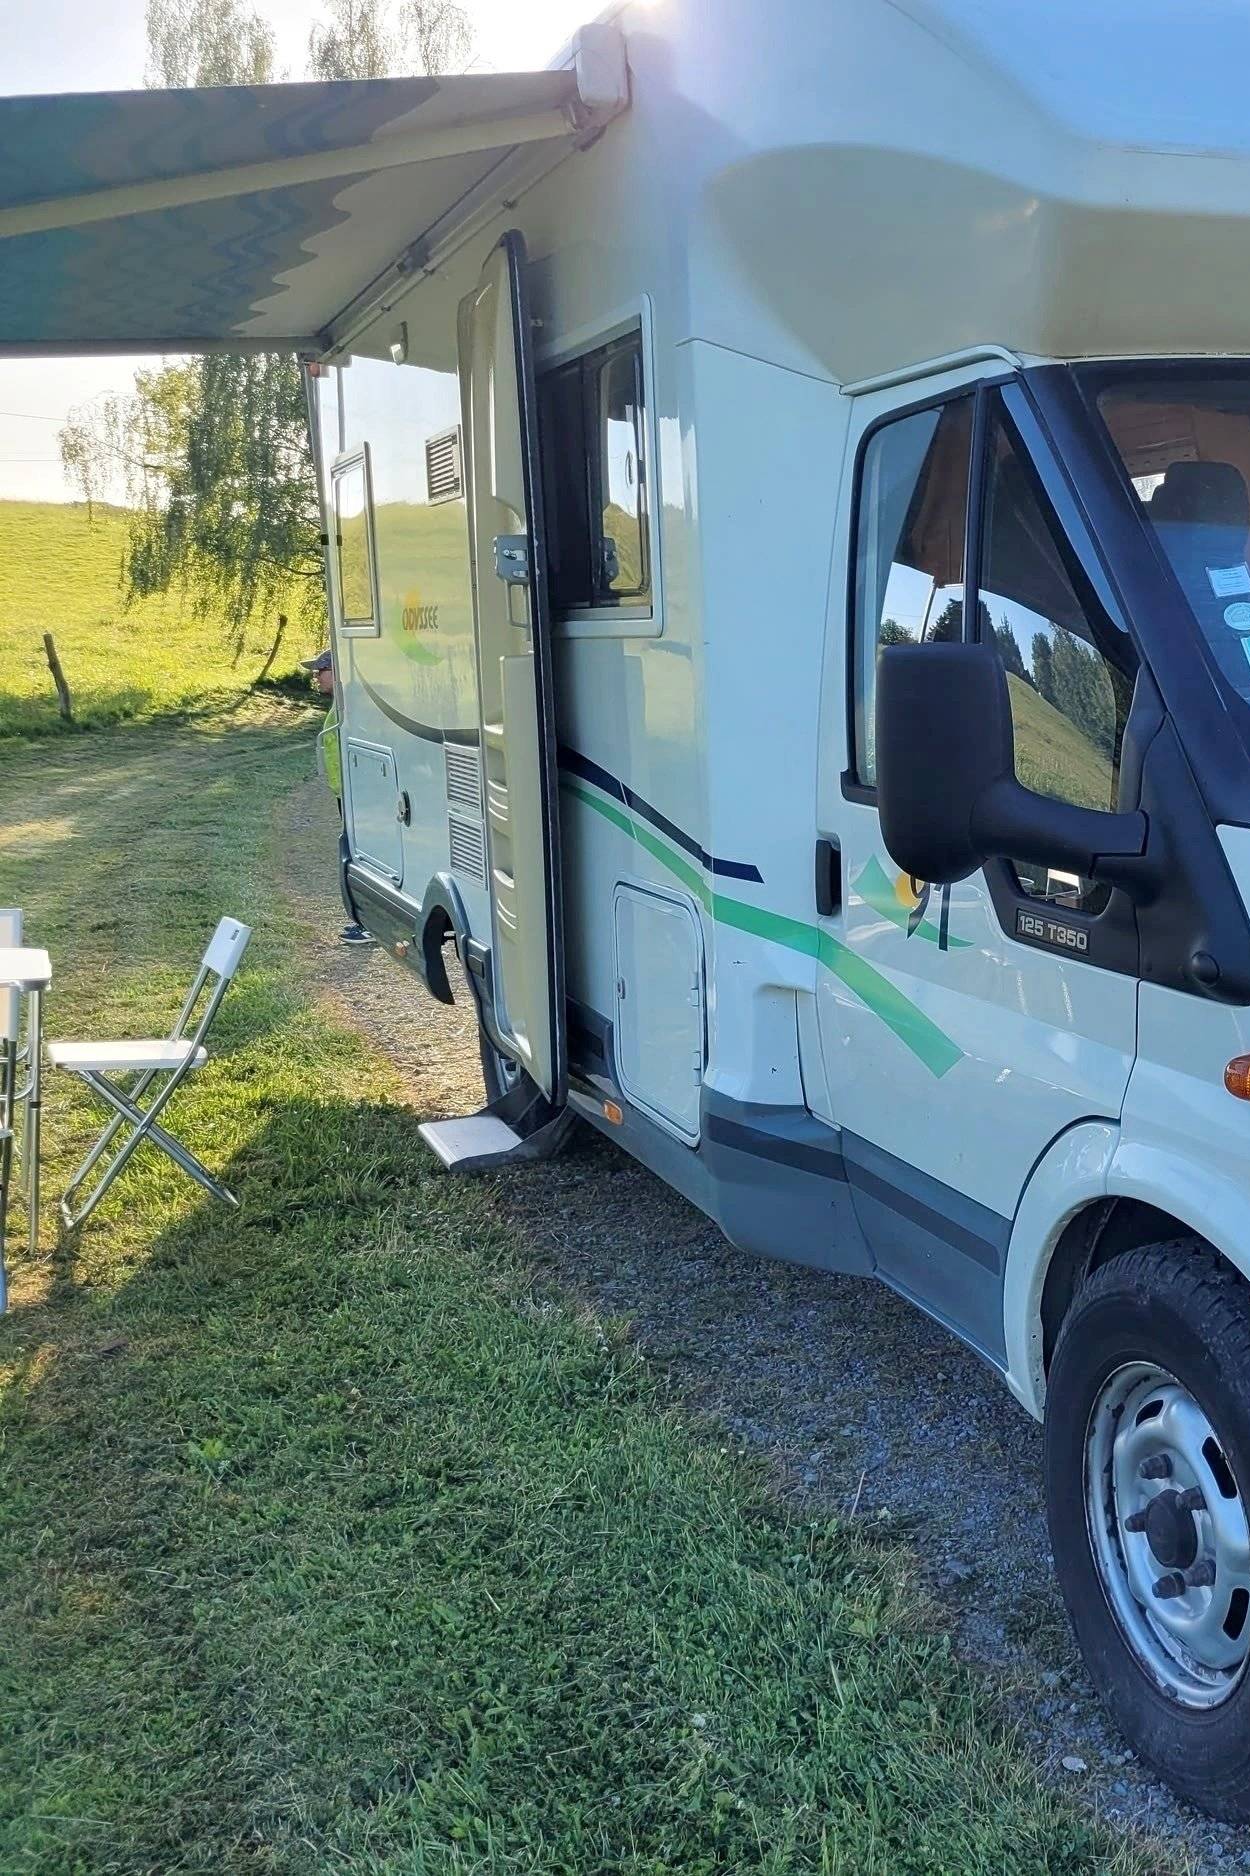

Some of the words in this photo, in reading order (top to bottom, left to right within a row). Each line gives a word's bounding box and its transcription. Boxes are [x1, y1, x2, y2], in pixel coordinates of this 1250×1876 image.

[402, 605, 439, 631] ODYSSEE
[1019, 915, 1044, 937] 125
[1047, 924, 1087, 950] T350
